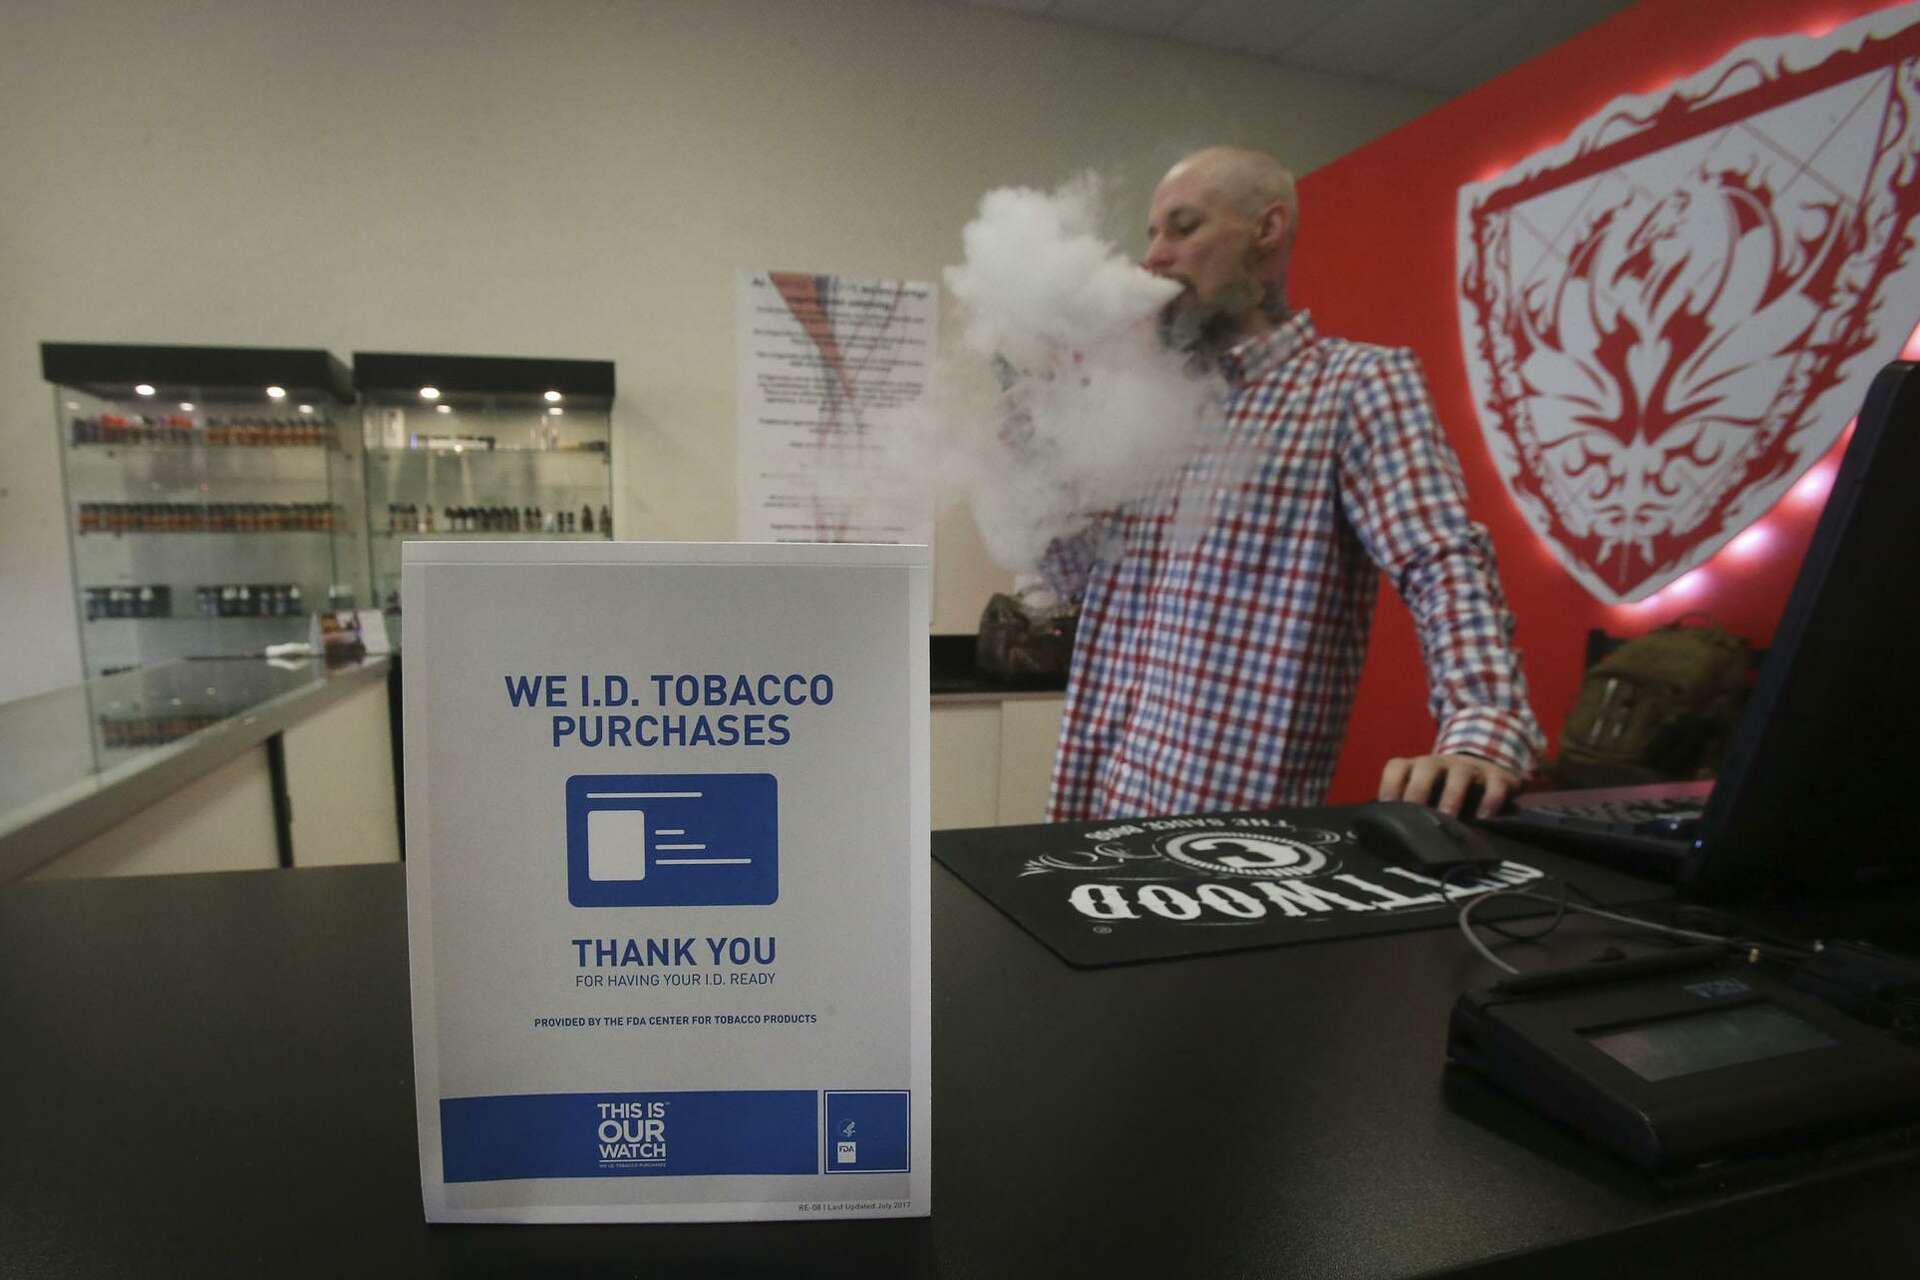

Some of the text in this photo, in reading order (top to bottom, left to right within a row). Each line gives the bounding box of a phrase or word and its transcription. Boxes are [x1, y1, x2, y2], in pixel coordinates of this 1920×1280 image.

[505, 673, 834, 708] WE I.D. TOBACCO
[552, 714, 791, 748] PURCHASES
[1068, 860, 1545, 921] TTWOOD
[571, 936, 776, 968] THANK YOU
[575, 972, 776, 988] FOR HAVING YOUR I.D. READY
[534, 1014, 817, 1028] PROVIDED BY THE FDA CENTER FOR TOBACCO PRODUCTS
[597, 1102, 666, 1119] THIS IS
[598, 1119, 666, 1144] OUR
[598, 1142, 667, 1159] WATCH
[839, 1145, 855, 1153] FDA
[845, 1203, 876, 1211] Updated
